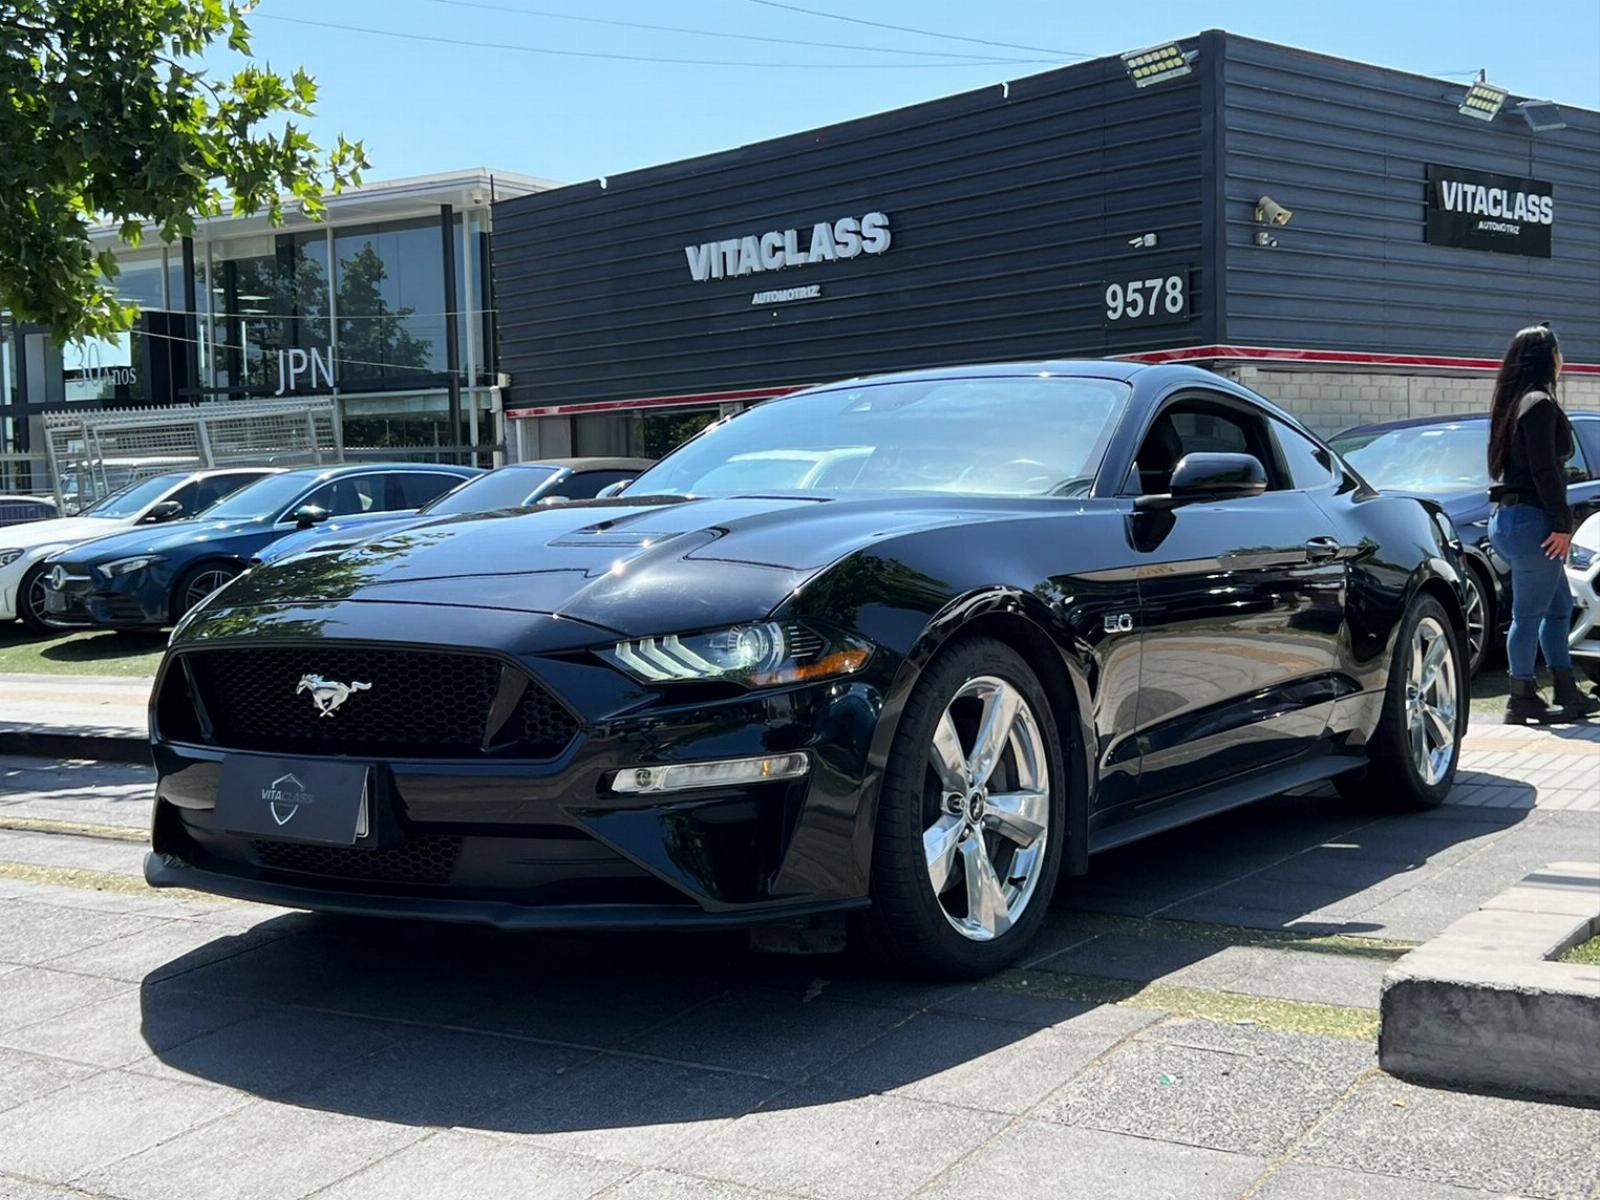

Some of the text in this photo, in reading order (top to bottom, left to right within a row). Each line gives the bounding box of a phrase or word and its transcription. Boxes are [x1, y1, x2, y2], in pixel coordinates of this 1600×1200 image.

[1442, 180, 1553, 224] VITACLASS
[685, 211, 891, 281] VITACLASS
[1478, 220, 1520, 235] AUTOMOTRIZ
[752, 284, 821, 304] AUTOMOTRIZ
[1105, 275, 1184, 320] 9578
[75, 343, 101, 388] 30
[275, 346, 334, 395] JPN
